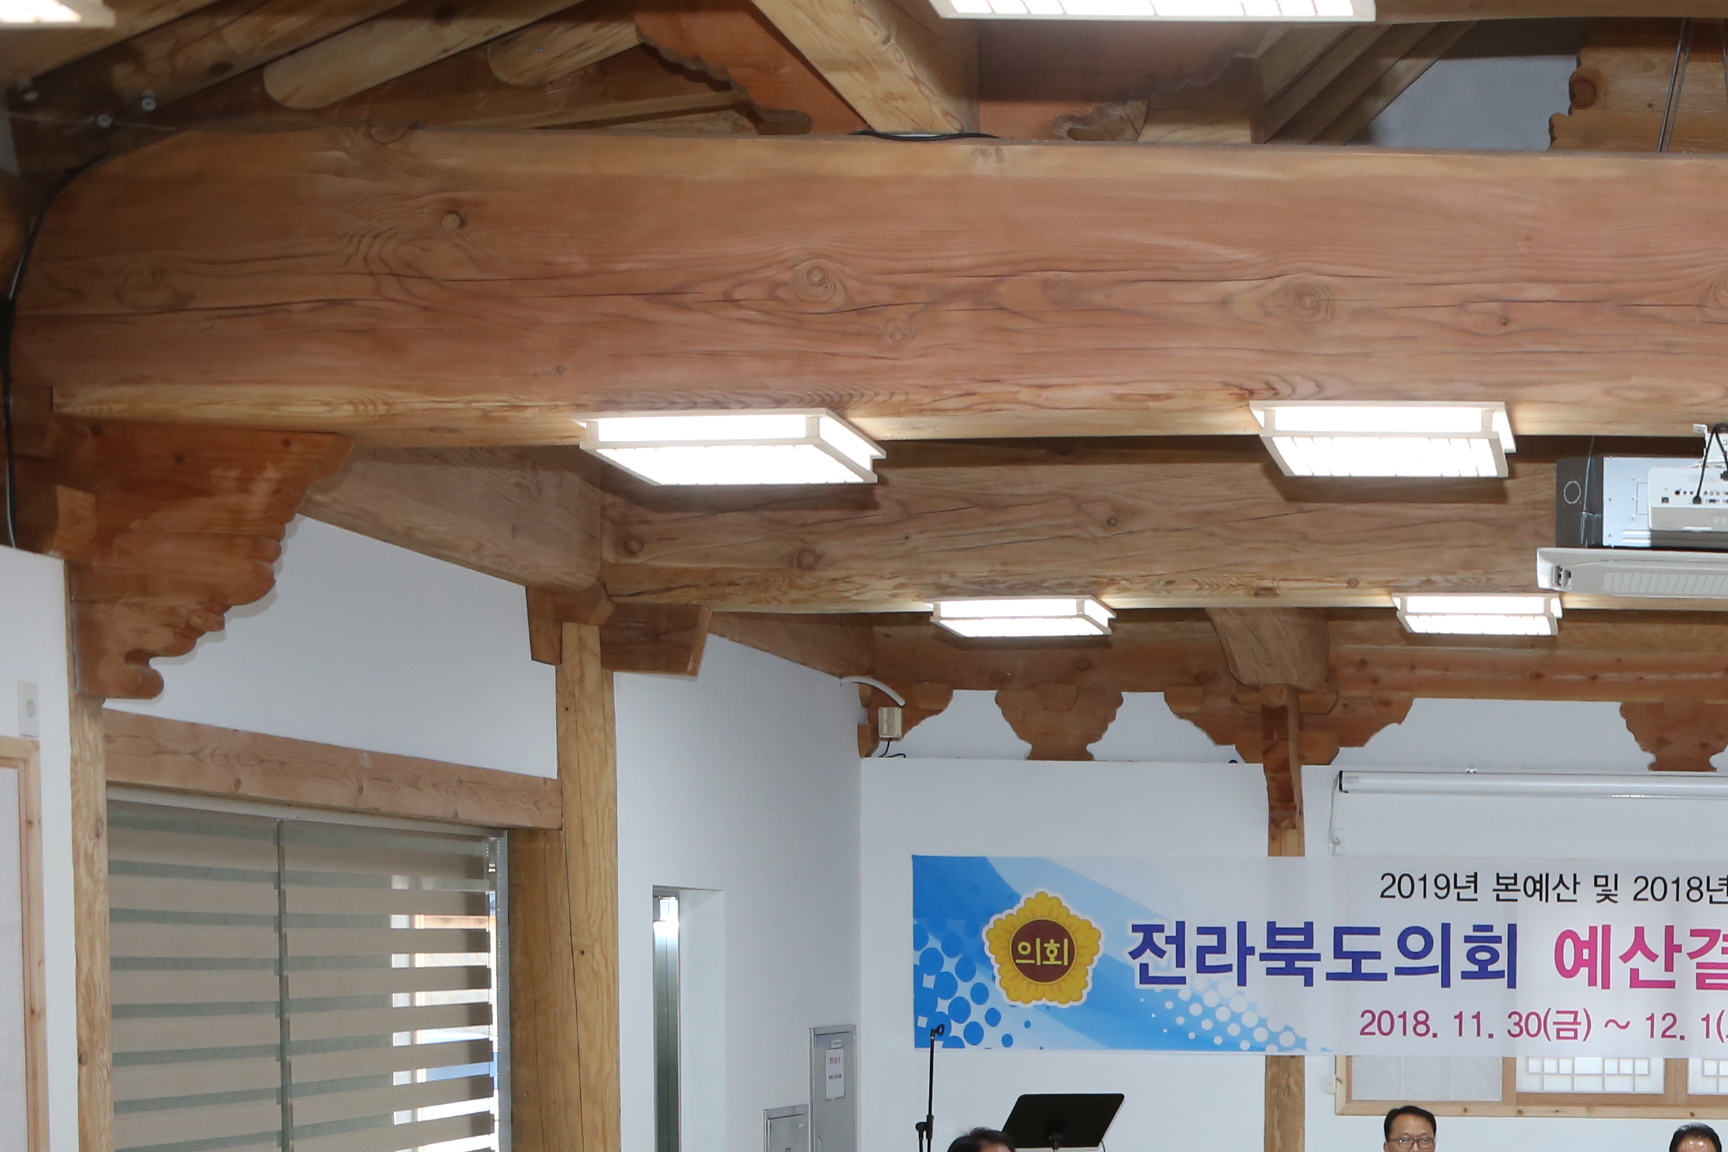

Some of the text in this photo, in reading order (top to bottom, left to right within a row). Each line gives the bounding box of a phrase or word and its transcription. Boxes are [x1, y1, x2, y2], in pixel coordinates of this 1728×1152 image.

[1379, 872, 1479, 902] 2019년
[1492, 873, 1581, 904] 본예산
[1593, 874, 1619, 904] 및
[1015, 939, 1069, 967] 의회
[1128, 920, 1517, 988] 전라북도의회
[1360, 1010, 1438, 1037] 2018.
[1454, 1012, 1494, 1038] 11.
[1507, 1010, 1593, 1041] 30(금)
[1646, 1013, 1686, 1041] 12.
